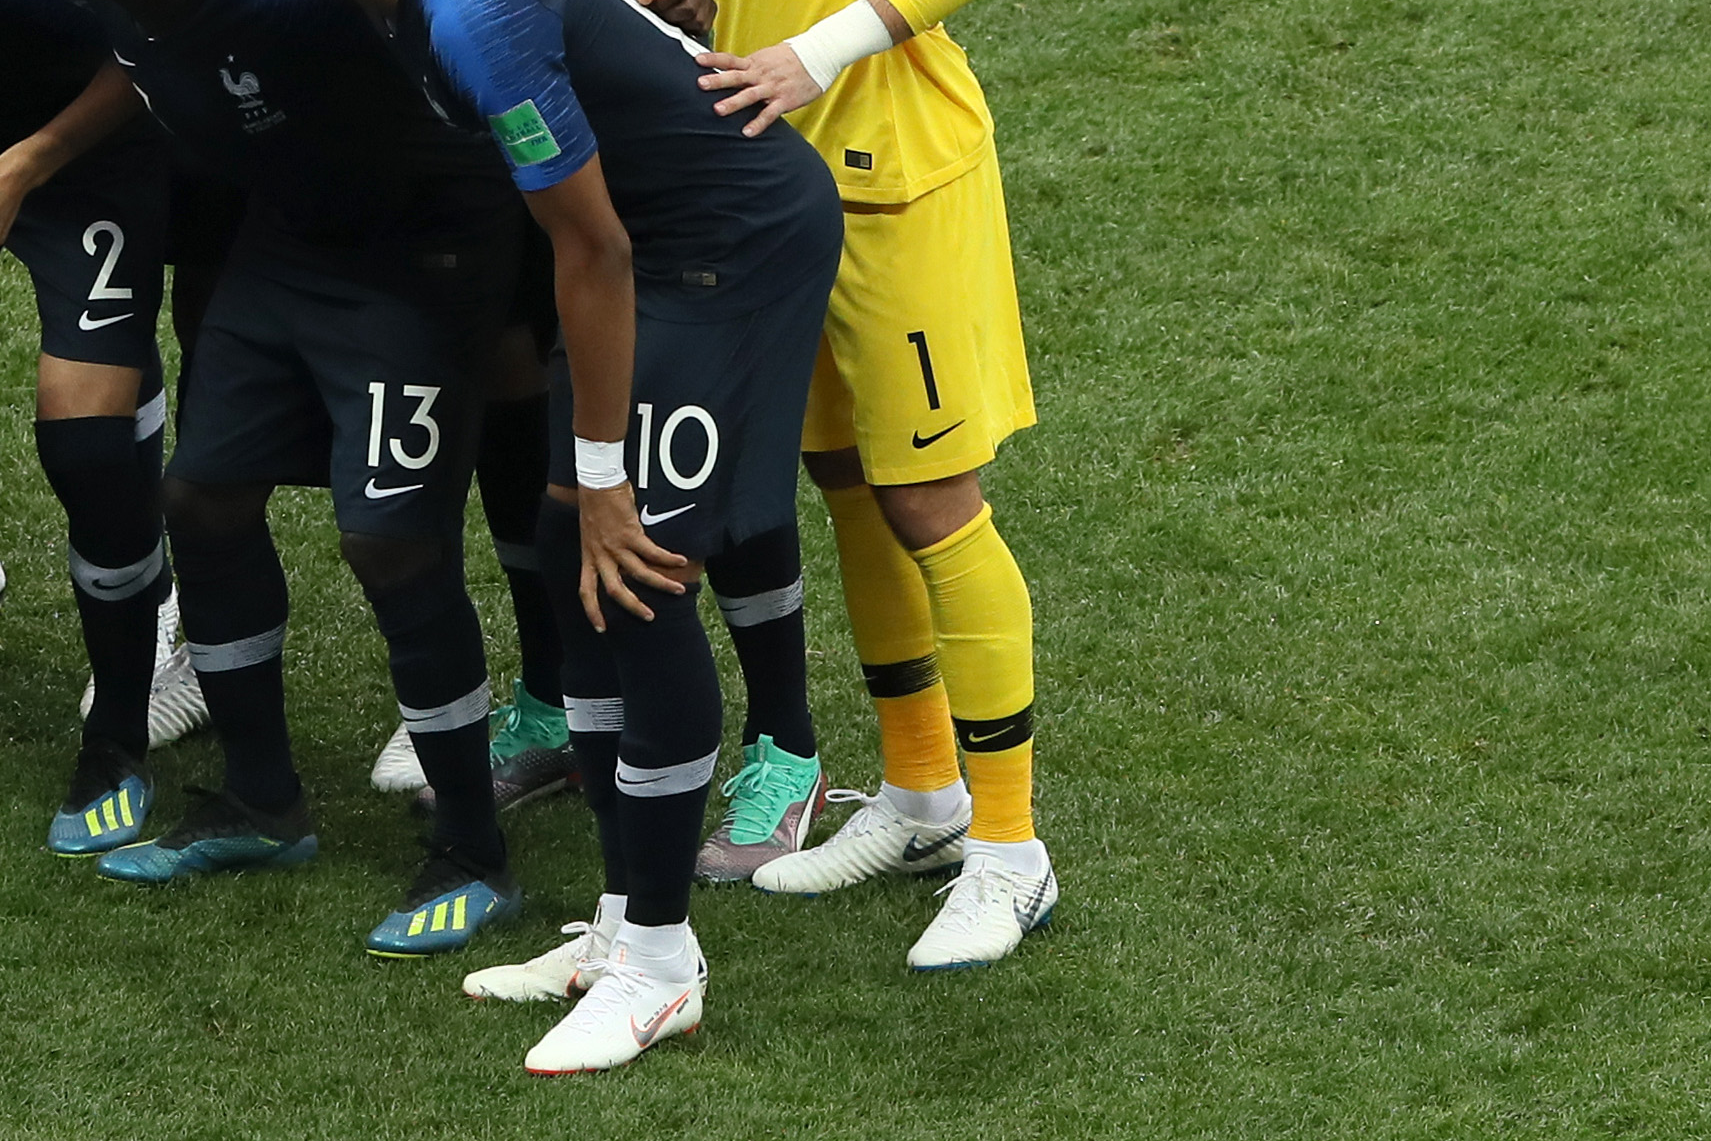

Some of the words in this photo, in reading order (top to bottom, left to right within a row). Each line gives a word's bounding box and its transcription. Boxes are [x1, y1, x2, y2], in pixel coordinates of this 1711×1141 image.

[82, 220, 133, 300] 2
[906, 331, 941, 411] 1
[368, 381, 442, 470] 13
[637, 403, 719, 490] 10
